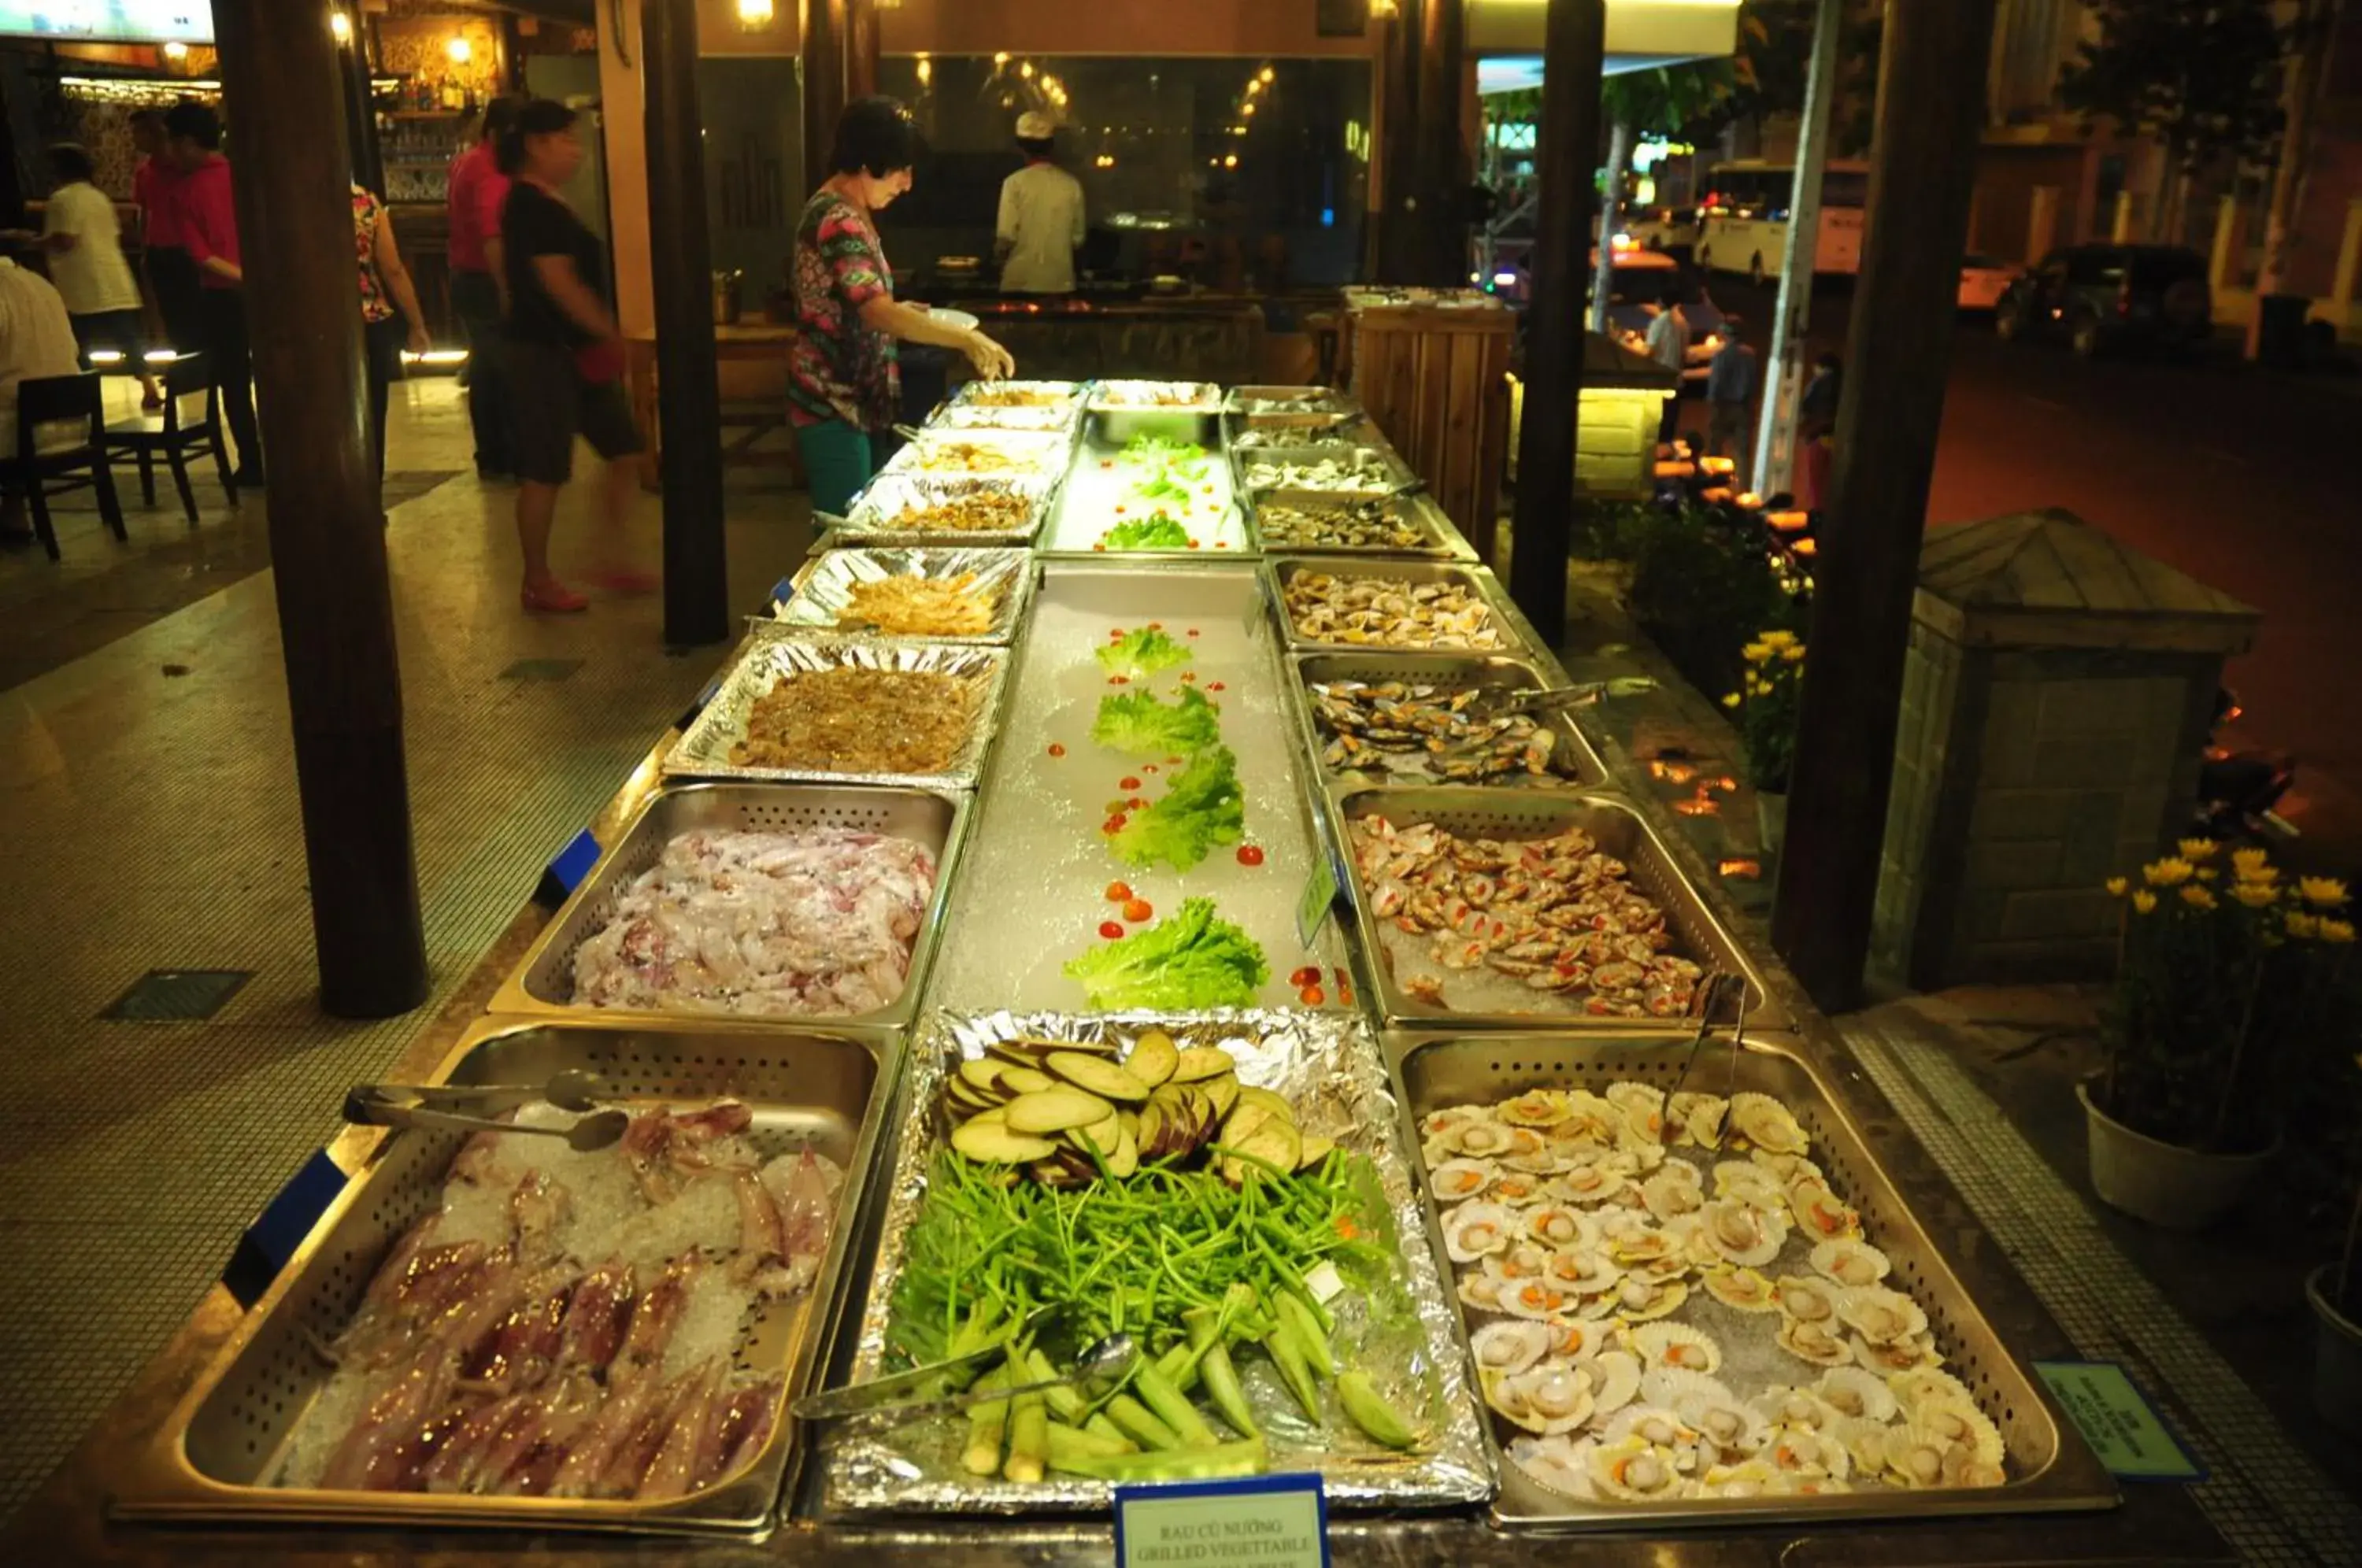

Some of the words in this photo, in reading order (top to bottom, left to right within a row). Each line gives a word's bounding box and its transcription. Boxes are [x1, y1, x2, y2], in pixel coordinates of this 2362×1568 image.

[1161, 1524, 1194, 1540] RAU
[1137, 1544, 1207, 1562] GRILLED
[1209, 1537, 1310, 1557] VEGETTABLE
